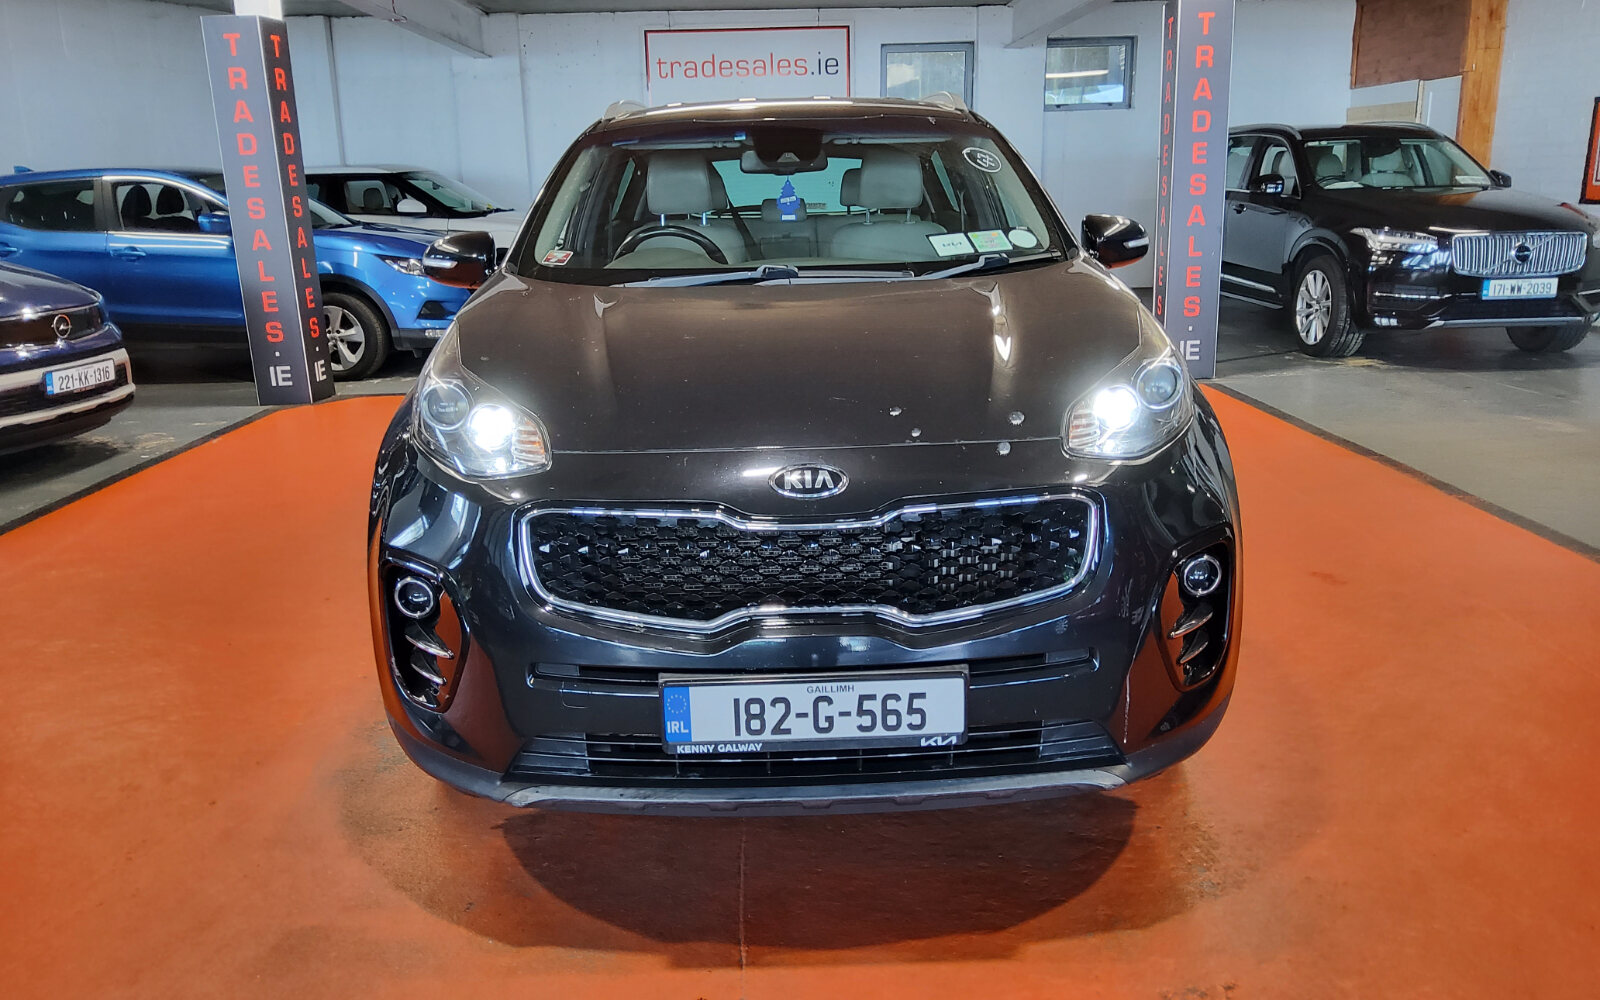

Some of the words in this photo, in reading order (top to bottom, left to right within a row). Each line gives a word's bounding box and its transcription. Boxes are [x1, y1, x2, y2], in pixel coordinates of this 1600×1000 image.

[656, 51, 839, 79] tradesales.ie
[1493, 282, 1552, 297] 171-WW-2039
[58, 366, 110, 391] 221-KK-1316
[784, 469, 834, 490] KIA
[806, 684, 855, 694] GAILLIMH
[732, 692, 927, 737] 182-G-565
[666, 720, 689, 734] IRL
[676, 744, 715, 754] KENNY
[717, 742, 763, 753] GALWAY
